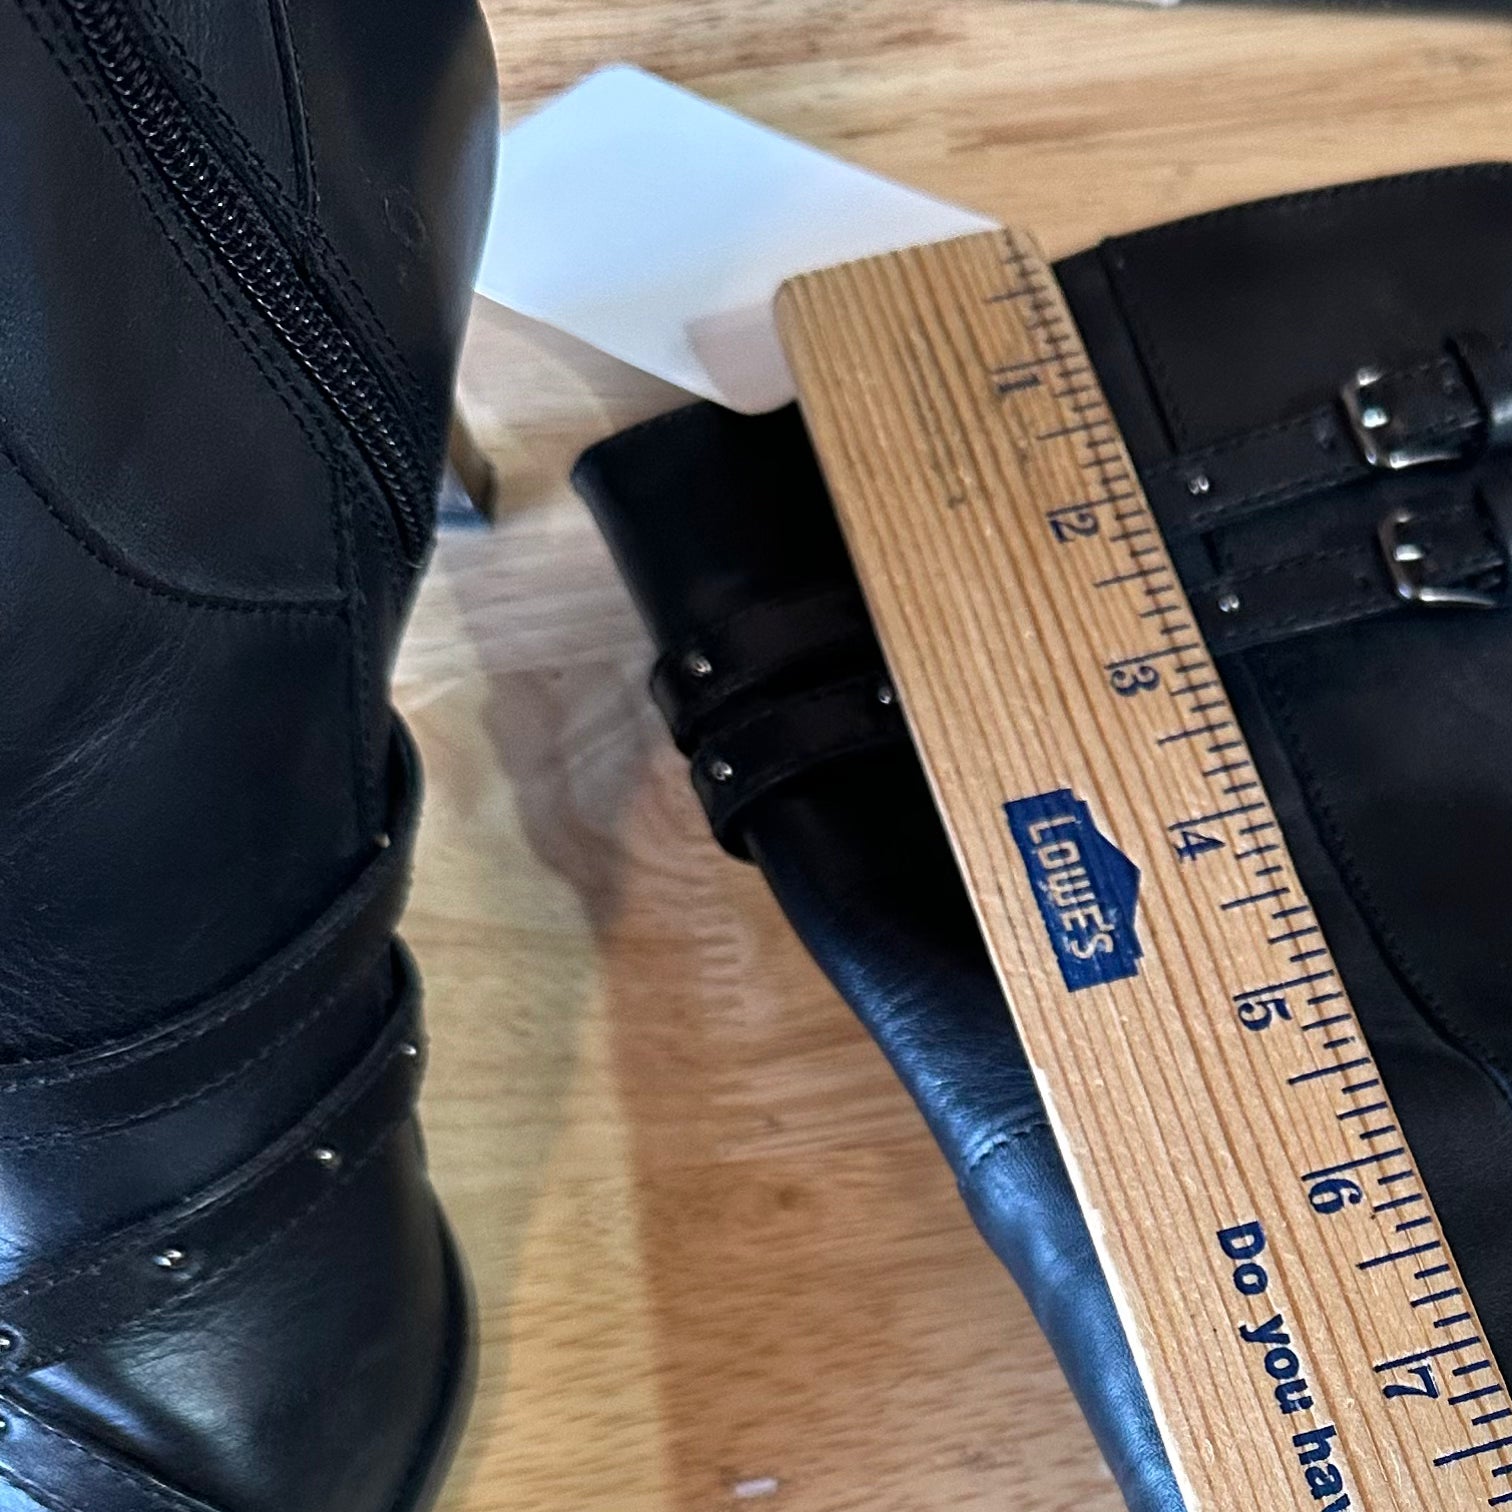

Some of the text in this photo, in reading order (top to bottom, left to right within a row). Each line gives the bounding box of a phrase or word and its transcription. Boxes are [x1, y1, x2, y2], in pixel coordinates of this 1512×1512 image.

[1050, 507, 1100, 544] 2
[1110, 663, 1160, 698] 3
[1174, 828, 1226, 863] 4
[1027, 814, 1115, 960] LOWE'S
[1238, 997, 1293, 1031] 5
[1308, 1178, 1363, 1214] 6
[1216, 1221, 1268, 1296] Do
[1238, 1313, 1314, 1415] you
[1382, 1364, 1440, 1399] 7
